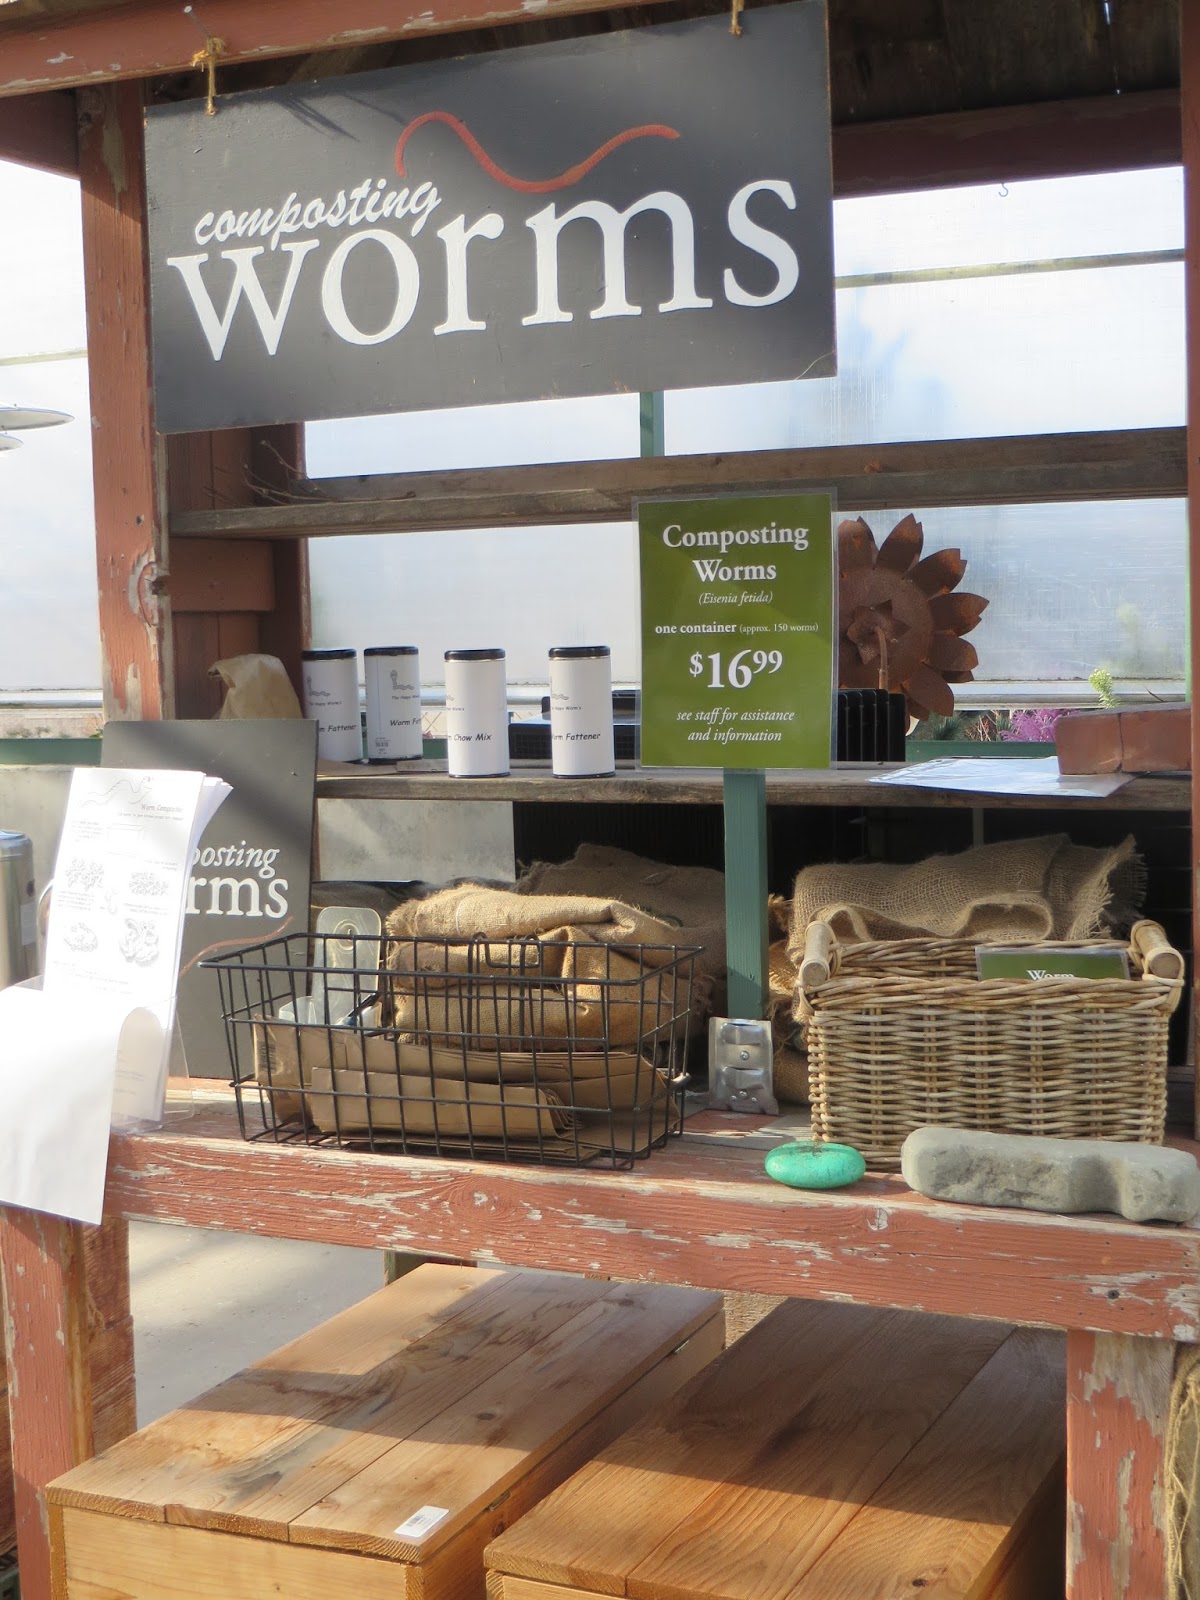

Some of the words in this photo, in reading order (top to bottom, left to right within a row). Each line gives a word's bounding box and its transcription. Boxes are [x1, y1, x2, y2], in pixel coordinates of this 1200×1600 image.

[194, 178, 442, 250] composting
[166, 179, 800, 362] worms
[662, 522, 809, 553] Composting
[692, 558, 777, 582] Worms
[698, 592, 737, 605] (Eisenia
[738, 591, 773, 606] fetida)
[655, 625, 677, 634] one
[680, 622, 737, 633] container
[739, 624, 770, 634] (approx.
[774, 623, 788, 632] 150
[790, 623, 818, 632] worms)
[676, 712, 692, 720] see
[695, 707, 722, 724] staff
[719, 707, 738, 724] for
[740, 709, 795, 720] assistance
[327, 724, 357, 732] Fattener
[688, 728, 711, 741] and
[713, 727, 782, 745] information
[475, 733, 492, 741] Mix
